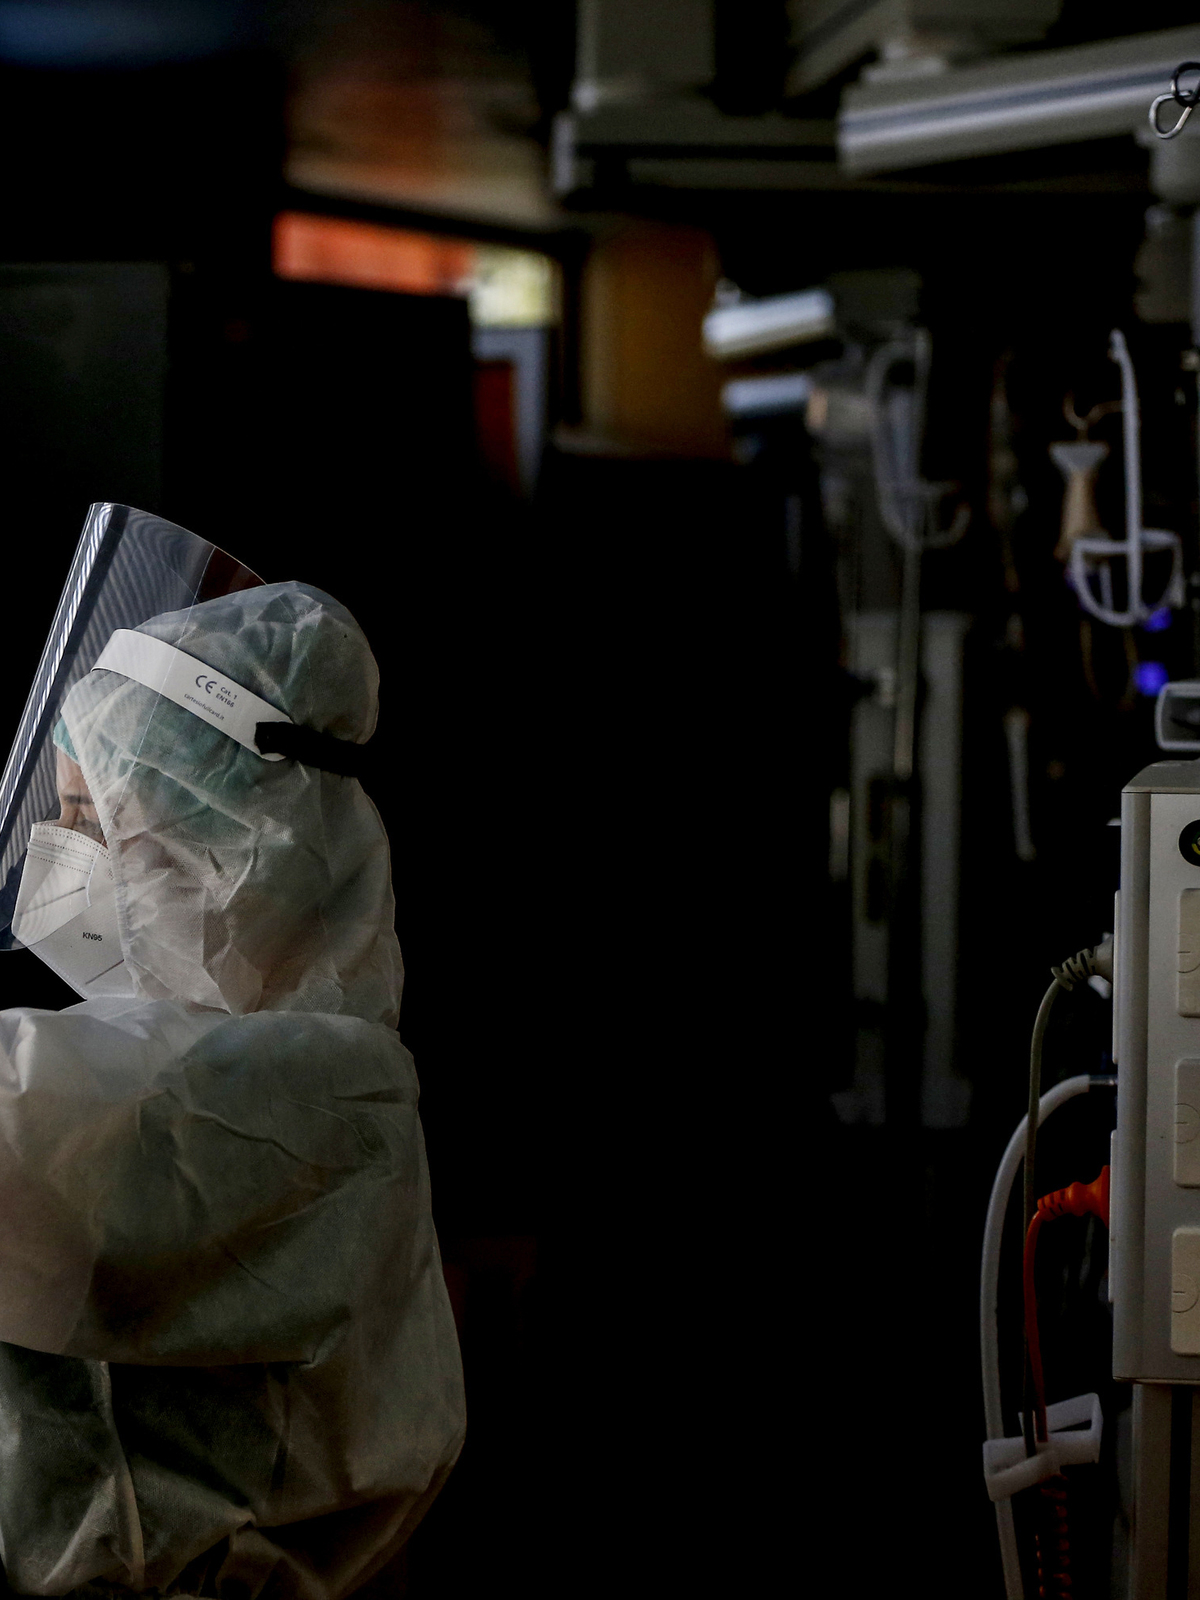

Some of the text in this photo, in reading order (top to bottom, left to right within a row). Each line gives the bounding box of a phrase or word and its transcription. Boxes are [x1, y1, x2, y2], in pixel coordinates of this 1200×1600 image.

[195, 675, 217, 694] CE
[220, 686, 231, 697] Cat.
[183, 693, 225, 720] cartesiofullcard.it
[215, 693, 235, 708] EN166
[82, 931, 103, 942] KN95
